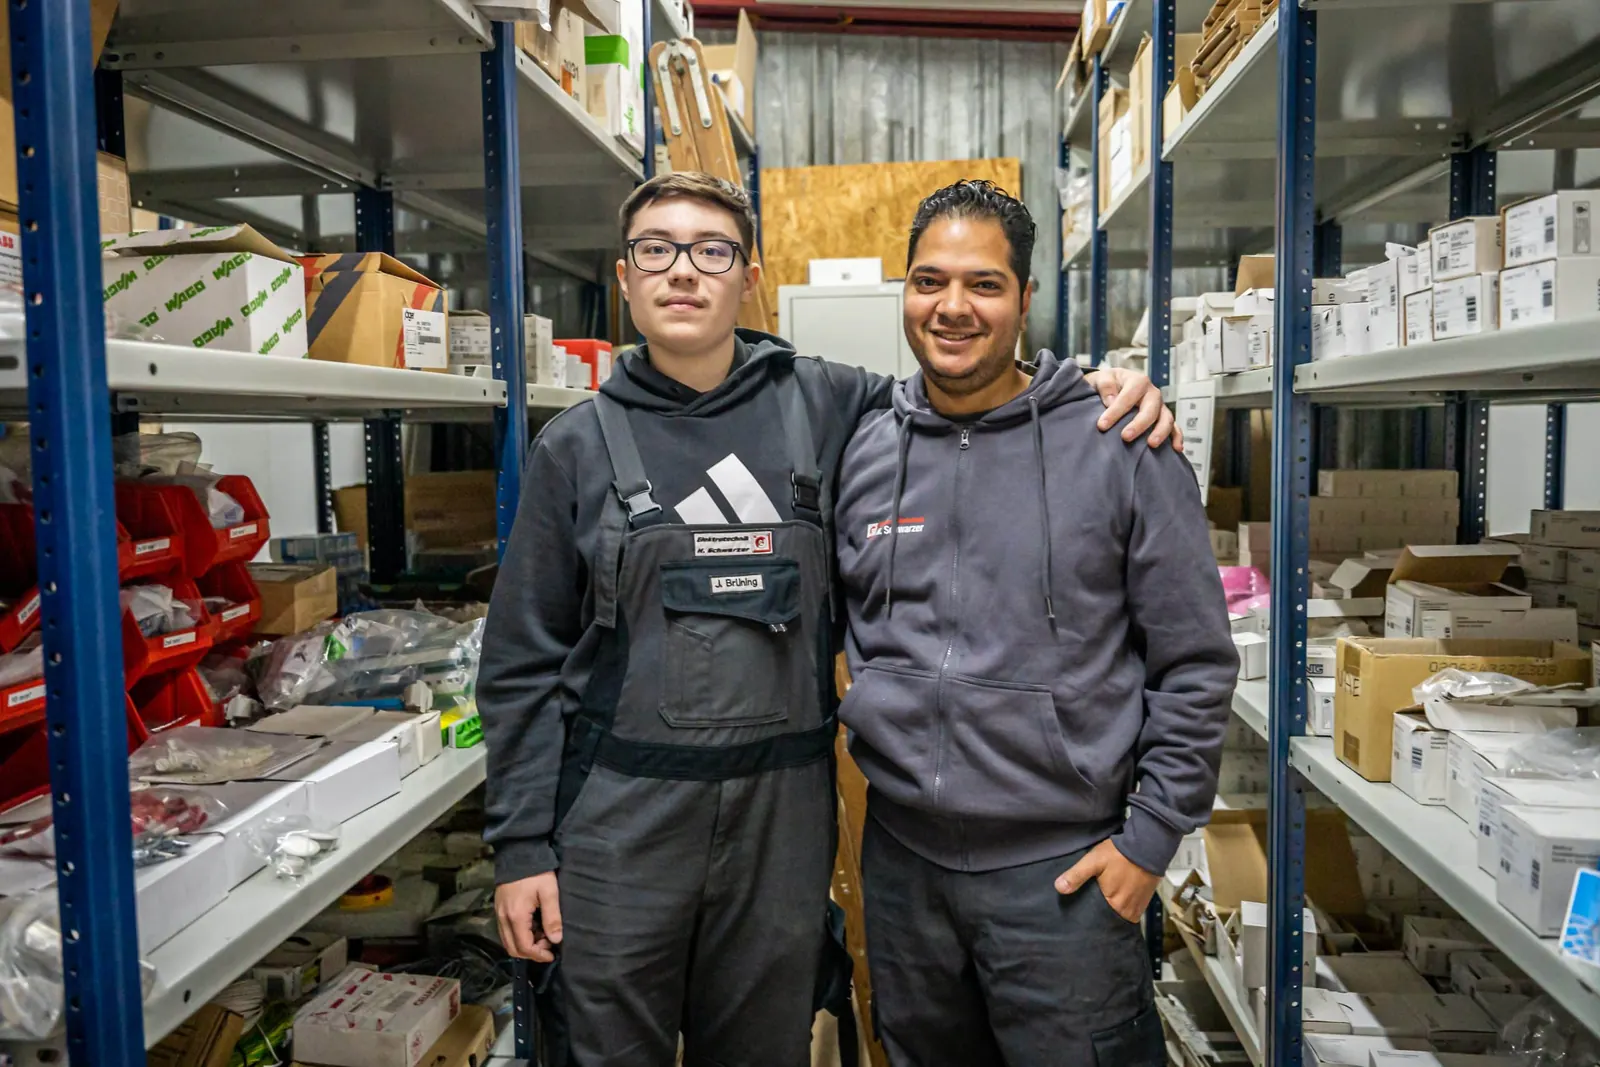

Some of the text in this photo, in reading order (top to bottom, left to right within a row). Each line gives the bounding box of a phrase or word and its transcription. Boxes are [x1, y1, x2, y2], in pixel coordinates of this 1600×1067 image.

[212, 252, 253, 281] WAGO
[270, 266, 292, 292] WAGO
[164, 279, 206, 313] WAGO
[240, 289, 268, 318] WAGO
[192, 316, 235, 348] WAGO
[282, 307, 302, 334] WAGO
[696, 535, 749, 543] Elektrotechnik
[715, 577, 758, 588] J. Brüning
